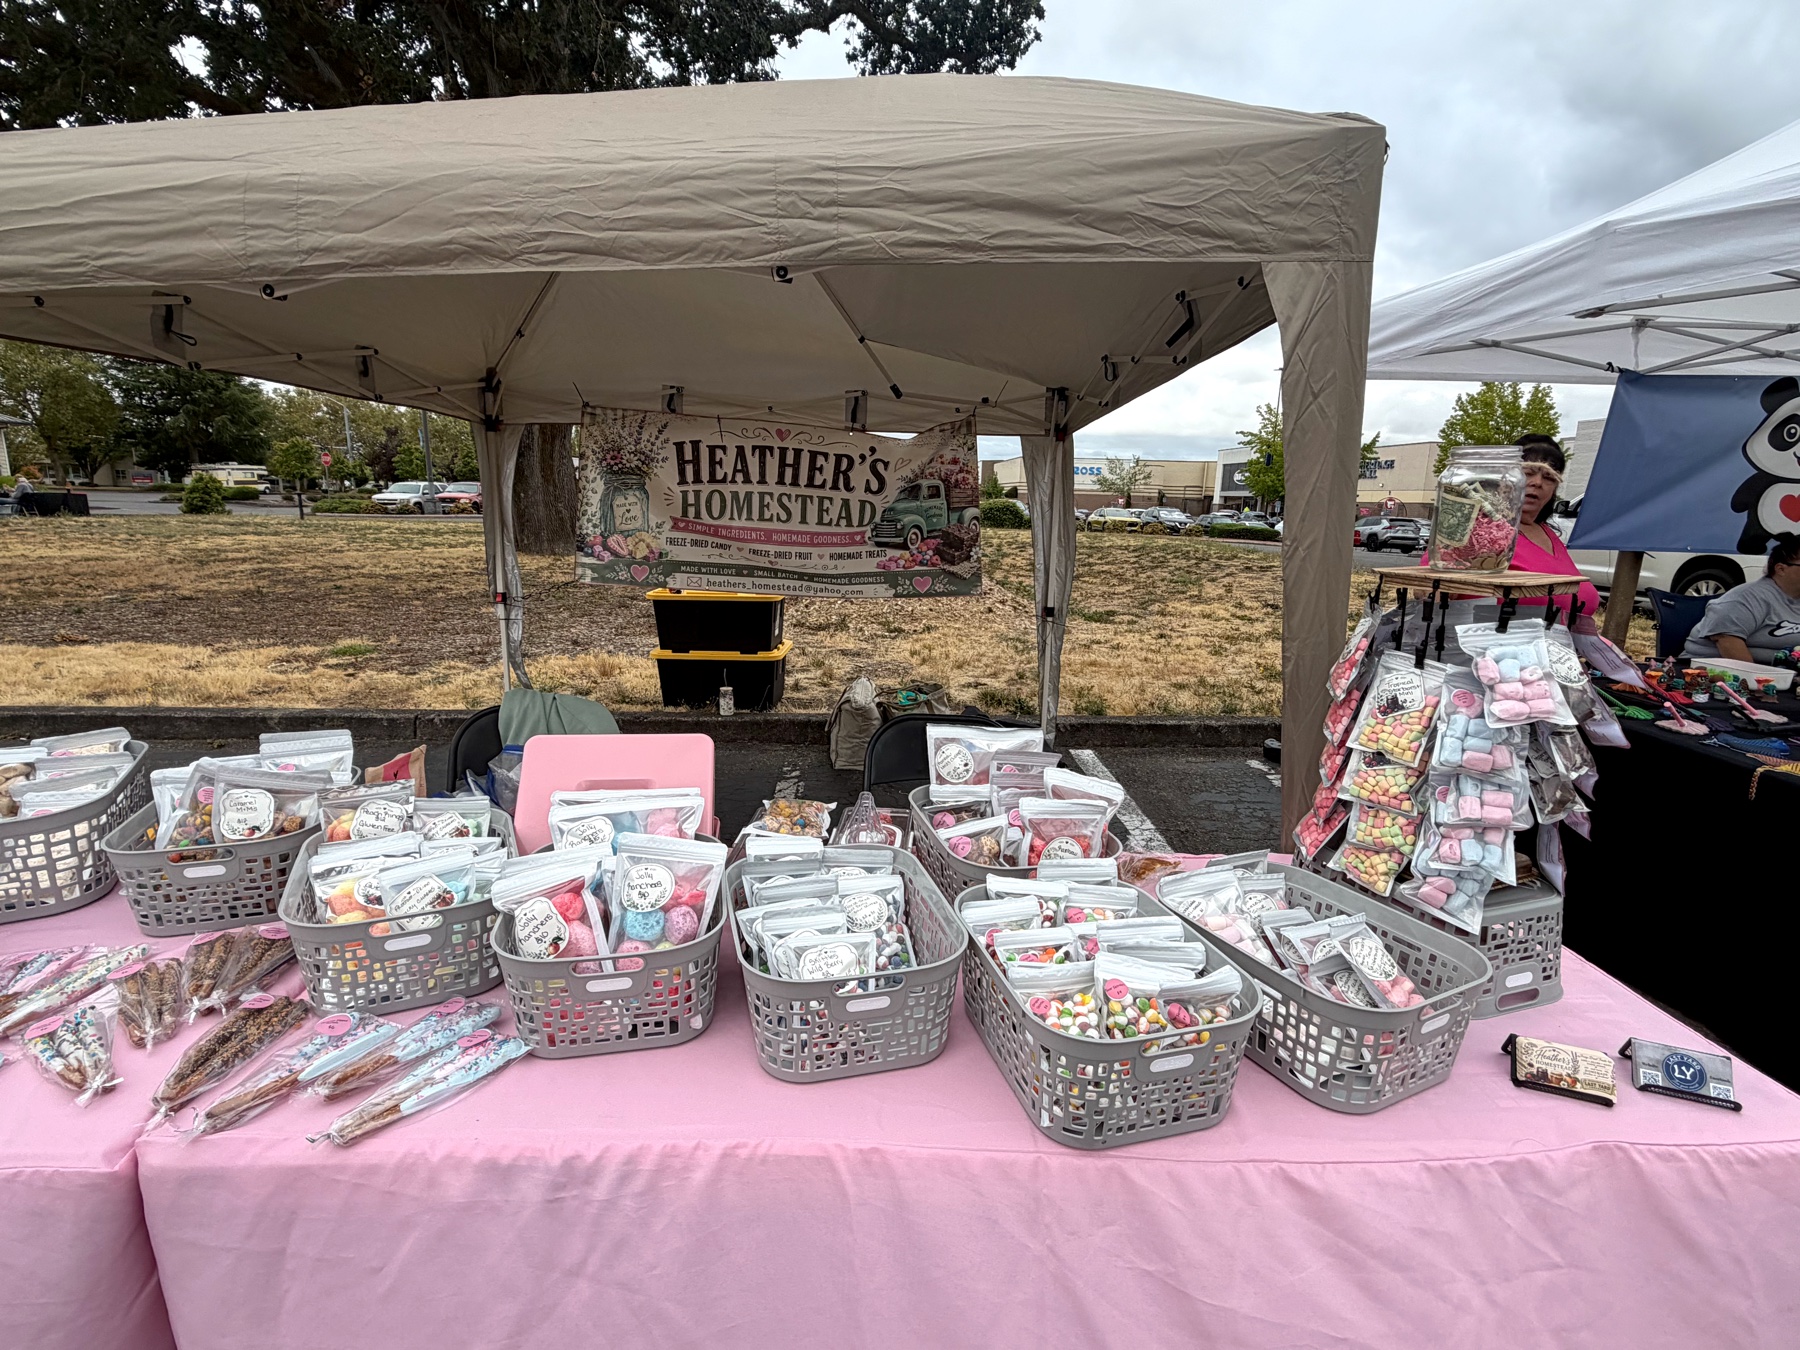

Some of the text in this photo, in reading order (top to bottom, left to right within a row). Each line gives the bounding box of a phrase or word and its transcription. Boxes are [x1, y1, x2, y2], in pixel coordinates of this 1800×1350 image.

[672, 439, 890, 496] HEATHER'S
[679, 488, 877, 528] HOMESTEAD
[618, 511, 640, 526] Love
[687, 522, 852, 544] SIMPLE INGREDIENTS. HOMEMADE GOODNESS.
[665, 536, 888, 561] FREEZE-DRIED CANDY FREEZE-DRIED FRUIT HOMEMADE TREATS
[680, 565, 699, 573] MADE
[753, 569, 776, 578] SMALL
[777, 570, 799, 580] BATCH
[813, 576, 851, 585] HOMEMADE
[851, 575, 885, 584] GOODNESS
[705, 577, 864, 596] heathers_homestead@yahoo.com
[229, 799, 257, 808] Caramel
[577, 824, 597, 836] Jolly
[635, 870, 654, 880] Jolly
[517, 913, 554, 946] Ranchers
[518, 913, 539, 932] Jolly
[806, 959, 844, 975] Wild Berry
[808, 953, 840, 966] Skittles
[1533, 1049, 1572, 1066] Heather's
[1535, 1059, 1574, 1073] HOMESTEAD
[1666, 1054, 1702, 1071] LAST YARD
[1673, 1064, 1695, 1081] LY
